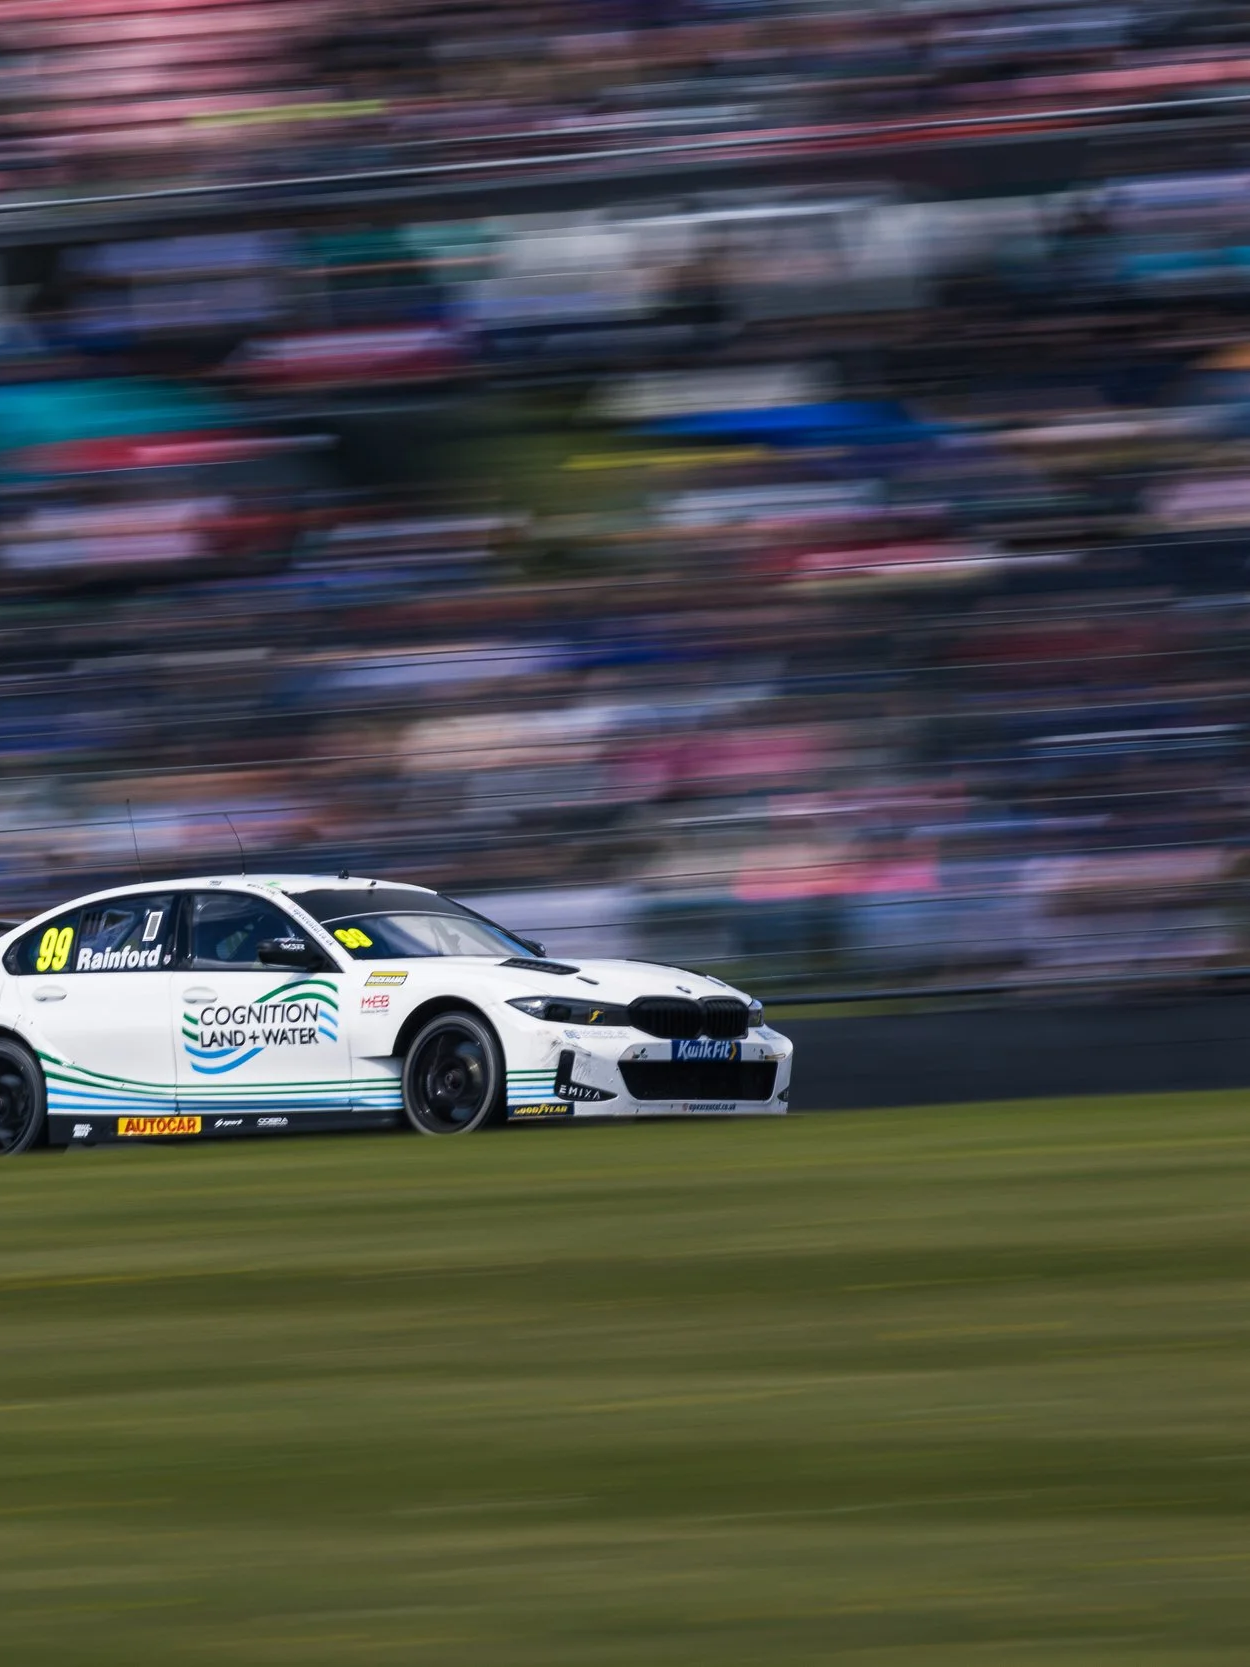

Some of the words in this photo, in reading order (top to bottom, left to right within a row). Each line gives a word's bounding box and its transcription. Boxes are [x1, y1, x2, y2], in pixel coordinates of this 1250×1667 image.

[334, 928, 373, 949] 99
[36, 927, 74, 972] 99
[76, 944, 163, 971] Rainford
[200, 1003, 319, 1026] COGNITION
[200, 1030, 246, 1048] LAND
[249, 1032, 261, 1044] +
[262, 1027, 319, 1046] WATER
[514, 1103, 568, 1115] GOODYEAR
[125, 1118, 197, 1133] AUTOCAR
